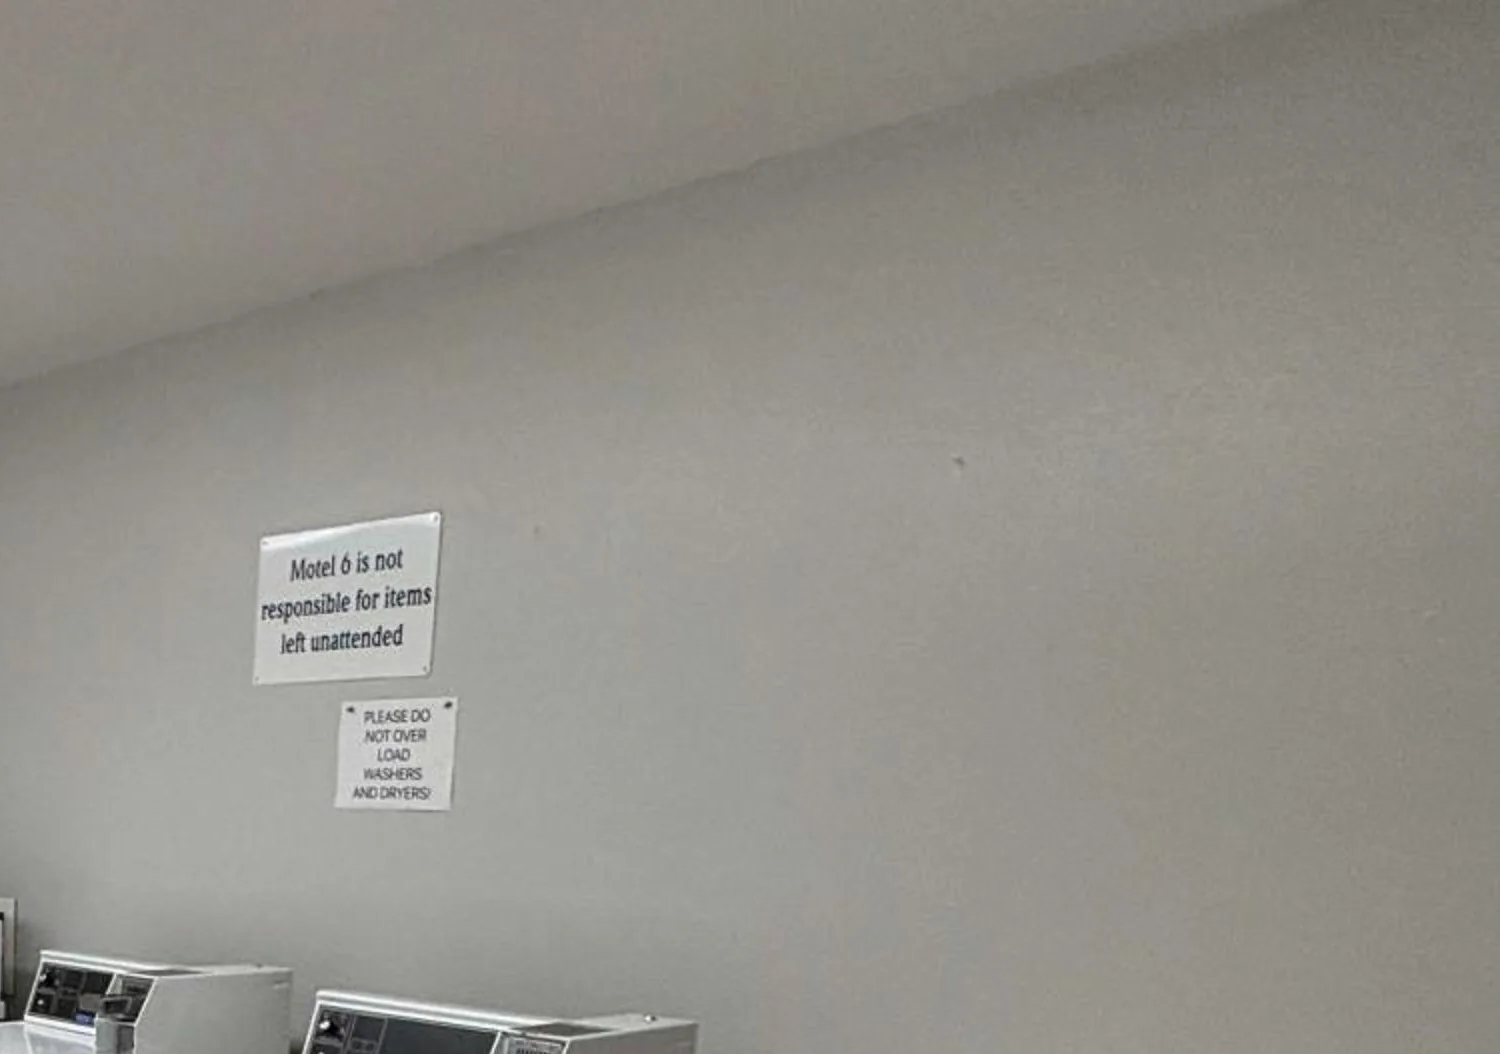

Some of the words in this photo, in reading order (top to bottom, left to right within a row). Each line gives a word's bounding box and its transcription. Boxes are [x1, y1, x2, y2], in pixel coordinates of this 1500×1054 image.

[290, 554, 336, 582] Motel
[341, 553, 351, 575] 6
[356, 551, 369, 573] is
[375, 549, 403, 571] not
[261, 592, 351, 624] responsible
[355, 588, 381, 611] for
[384, 585, 432, 609] items
[280, 632, 306, 655] left
[311, 624, 404, 652] unattended
[363, 709, 408, 724] PLEASE
[411, 708, 431, 722] DO
[364, 730, 391, 743] NOT
[393, 728, 426, 743] OVER
[377, 747, 411, 762] LOAD
[363, 767, 423, 781] WASHERS
[353, 785, 379, 800] AND
